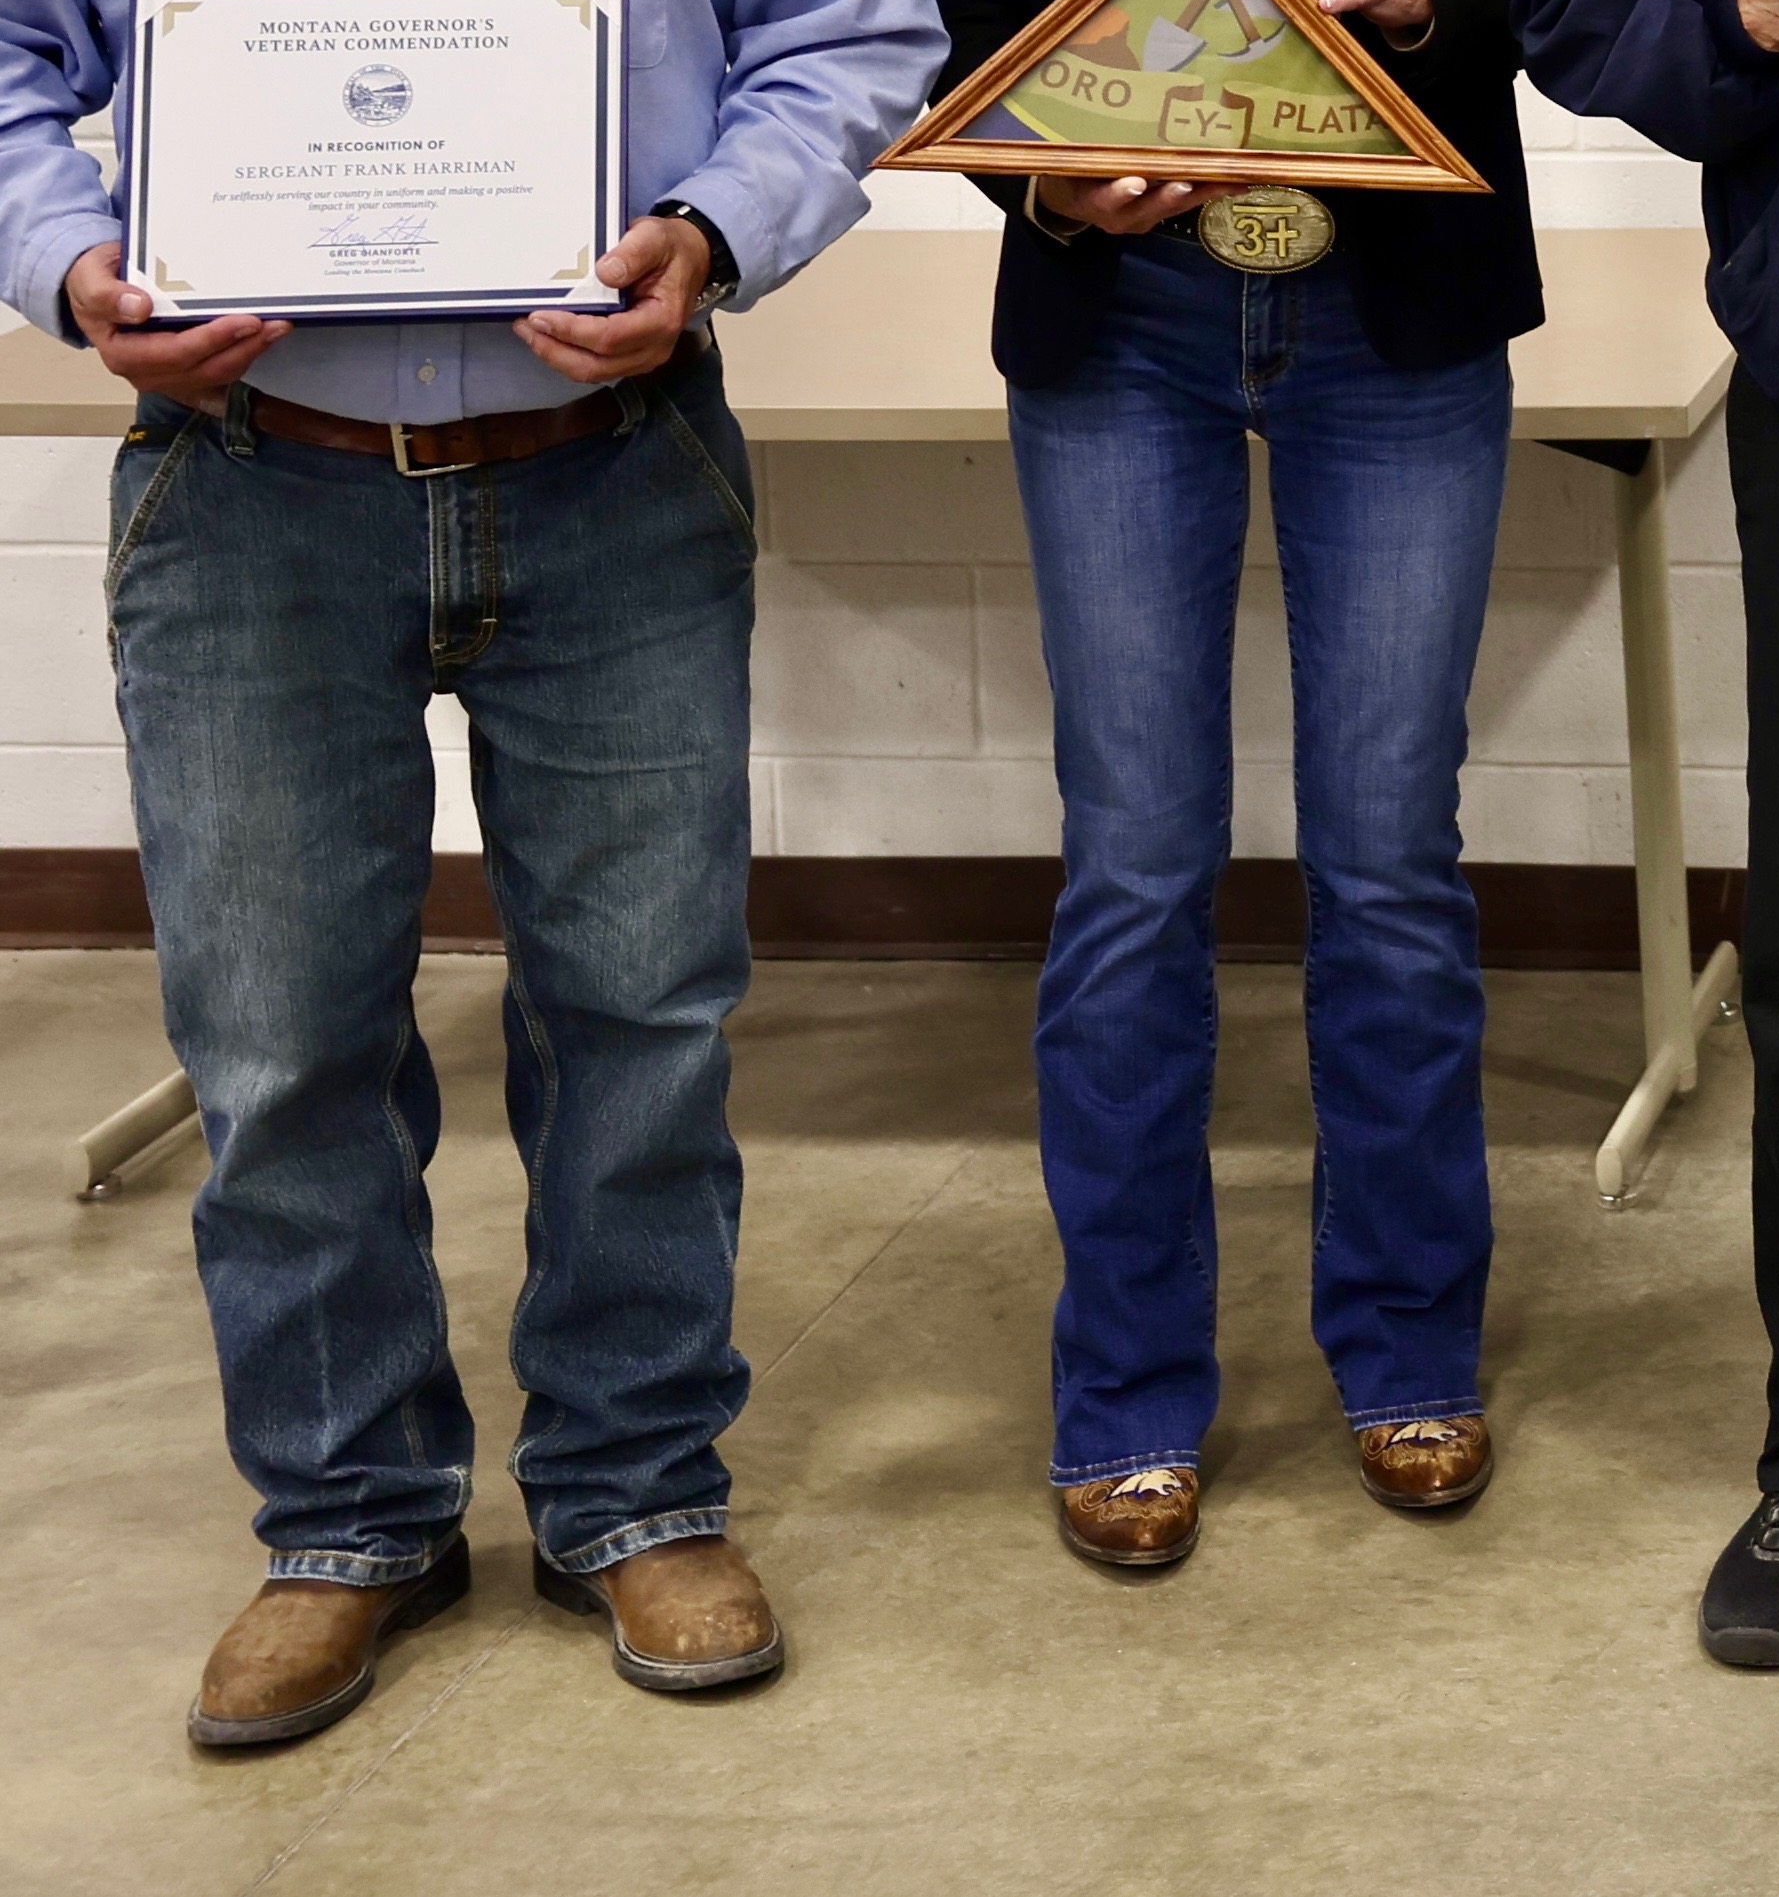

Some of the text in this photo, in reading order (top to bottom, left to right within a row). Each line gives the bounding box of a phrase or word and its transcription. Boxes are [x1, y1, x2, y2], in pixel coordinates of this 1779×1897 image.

[260, 18, 494, 34] MONTANA GOVERNOR'S
[243, 35, 509, 52] VETERAN COMMENDATION
[1039, 58, 1132, 108] ORO
[307, 139, 445, 152] IN RECOGNITION OF
[234, 160, 515, 179] SERGEANT FRANK HARRIMAN
[211, 191, 228, 203] for
[229, 190, 274, 202] selflessly
[275, 190, 313, 201] serving
[313, 191, 332, 199] our
[333, 189, 371, 199] country
[372, 187, 383, 197] in
[385, 186, 425, 198] uniform
[426, 185, 446, 196] and
[448, 185, 485, 197] making
[494, 184, 534, 196] positive
[308, 200, 438, 213] impact in your community.
[328, 248, 357, 257] GREG
